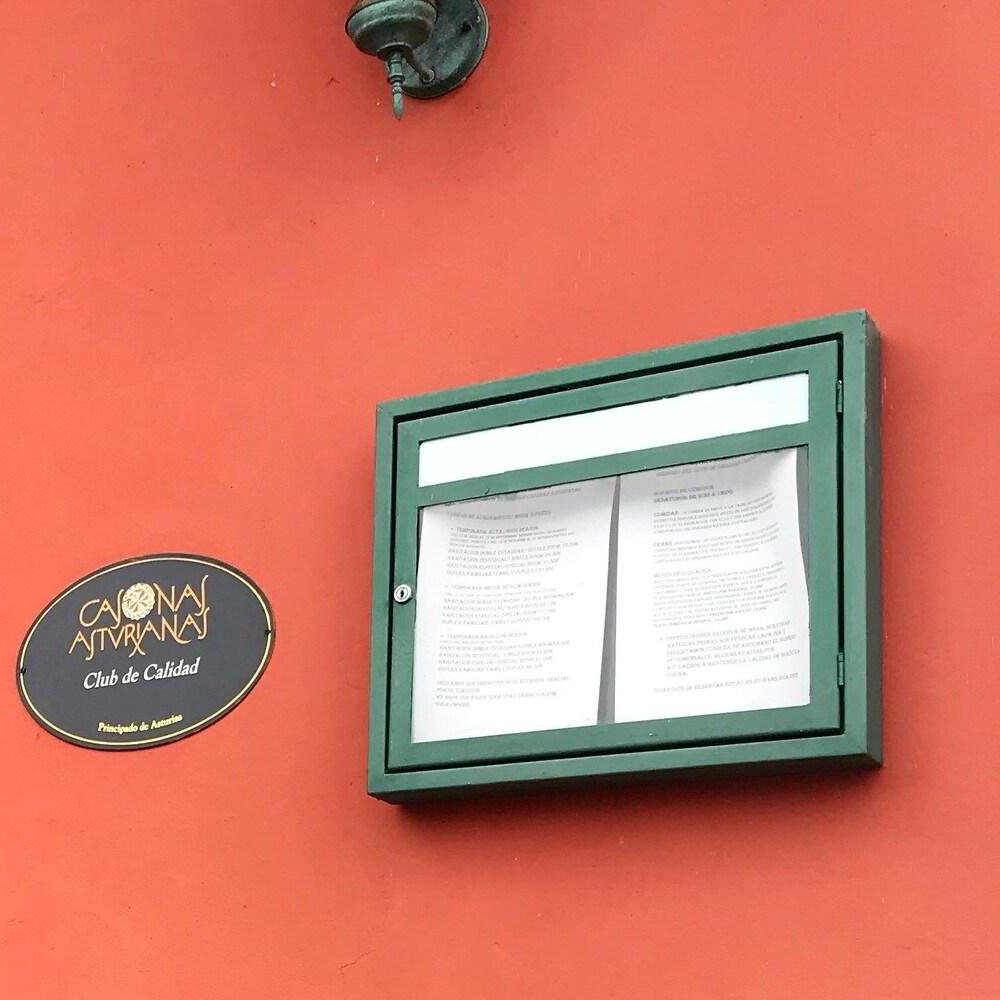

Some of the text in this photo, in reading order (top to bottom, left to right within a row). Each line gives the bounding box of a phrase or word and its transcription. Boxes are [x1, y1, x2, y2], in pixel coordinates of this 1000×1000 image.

[83, 656, 201, 690] Club de Calidad
[97, 714, 183, 735] Principado de Asturias
